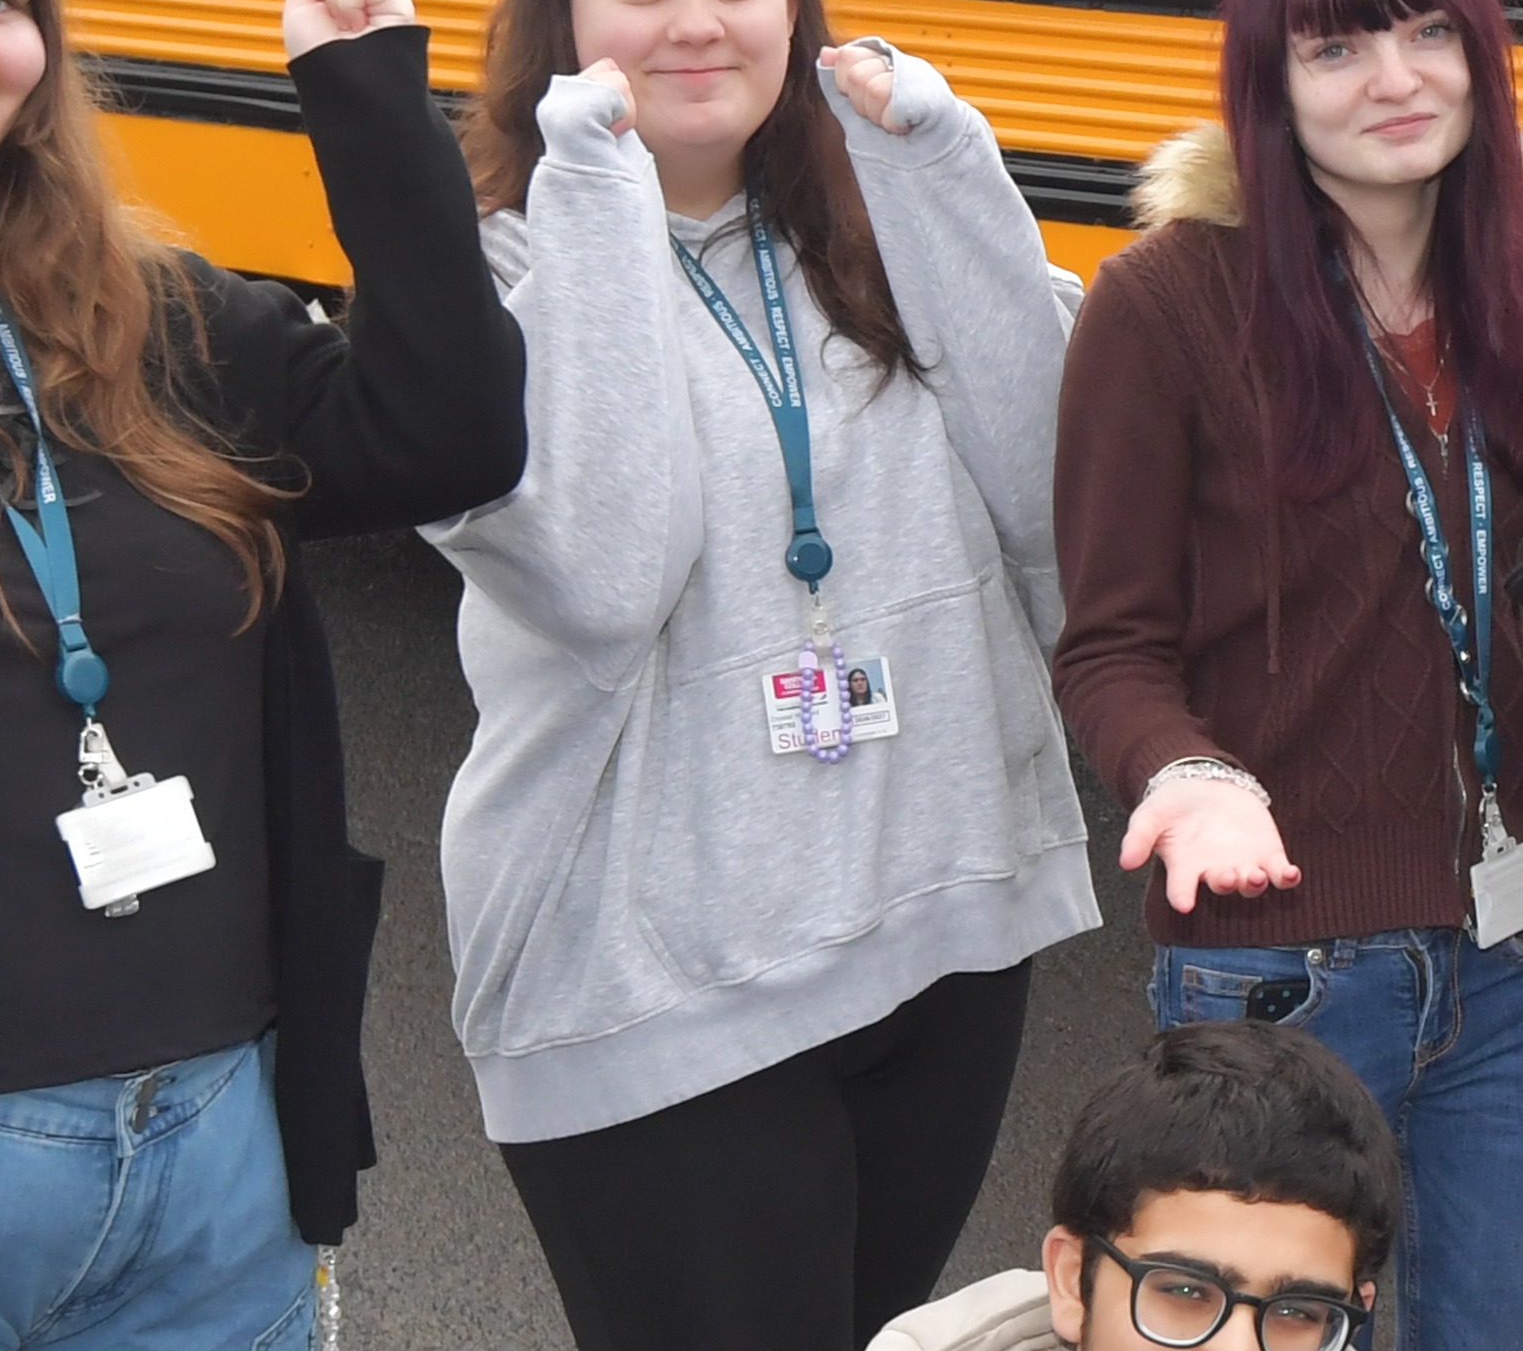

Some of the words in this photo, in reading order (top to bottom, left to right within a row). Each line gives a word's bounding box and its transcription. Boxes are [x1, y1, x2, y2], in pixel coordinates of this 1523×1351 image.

[1471, 462, 1487, 521] RESPECT
[1475, 530, 1488, 595] EMPOWER
[778, 728, 843, 749] Stuen
